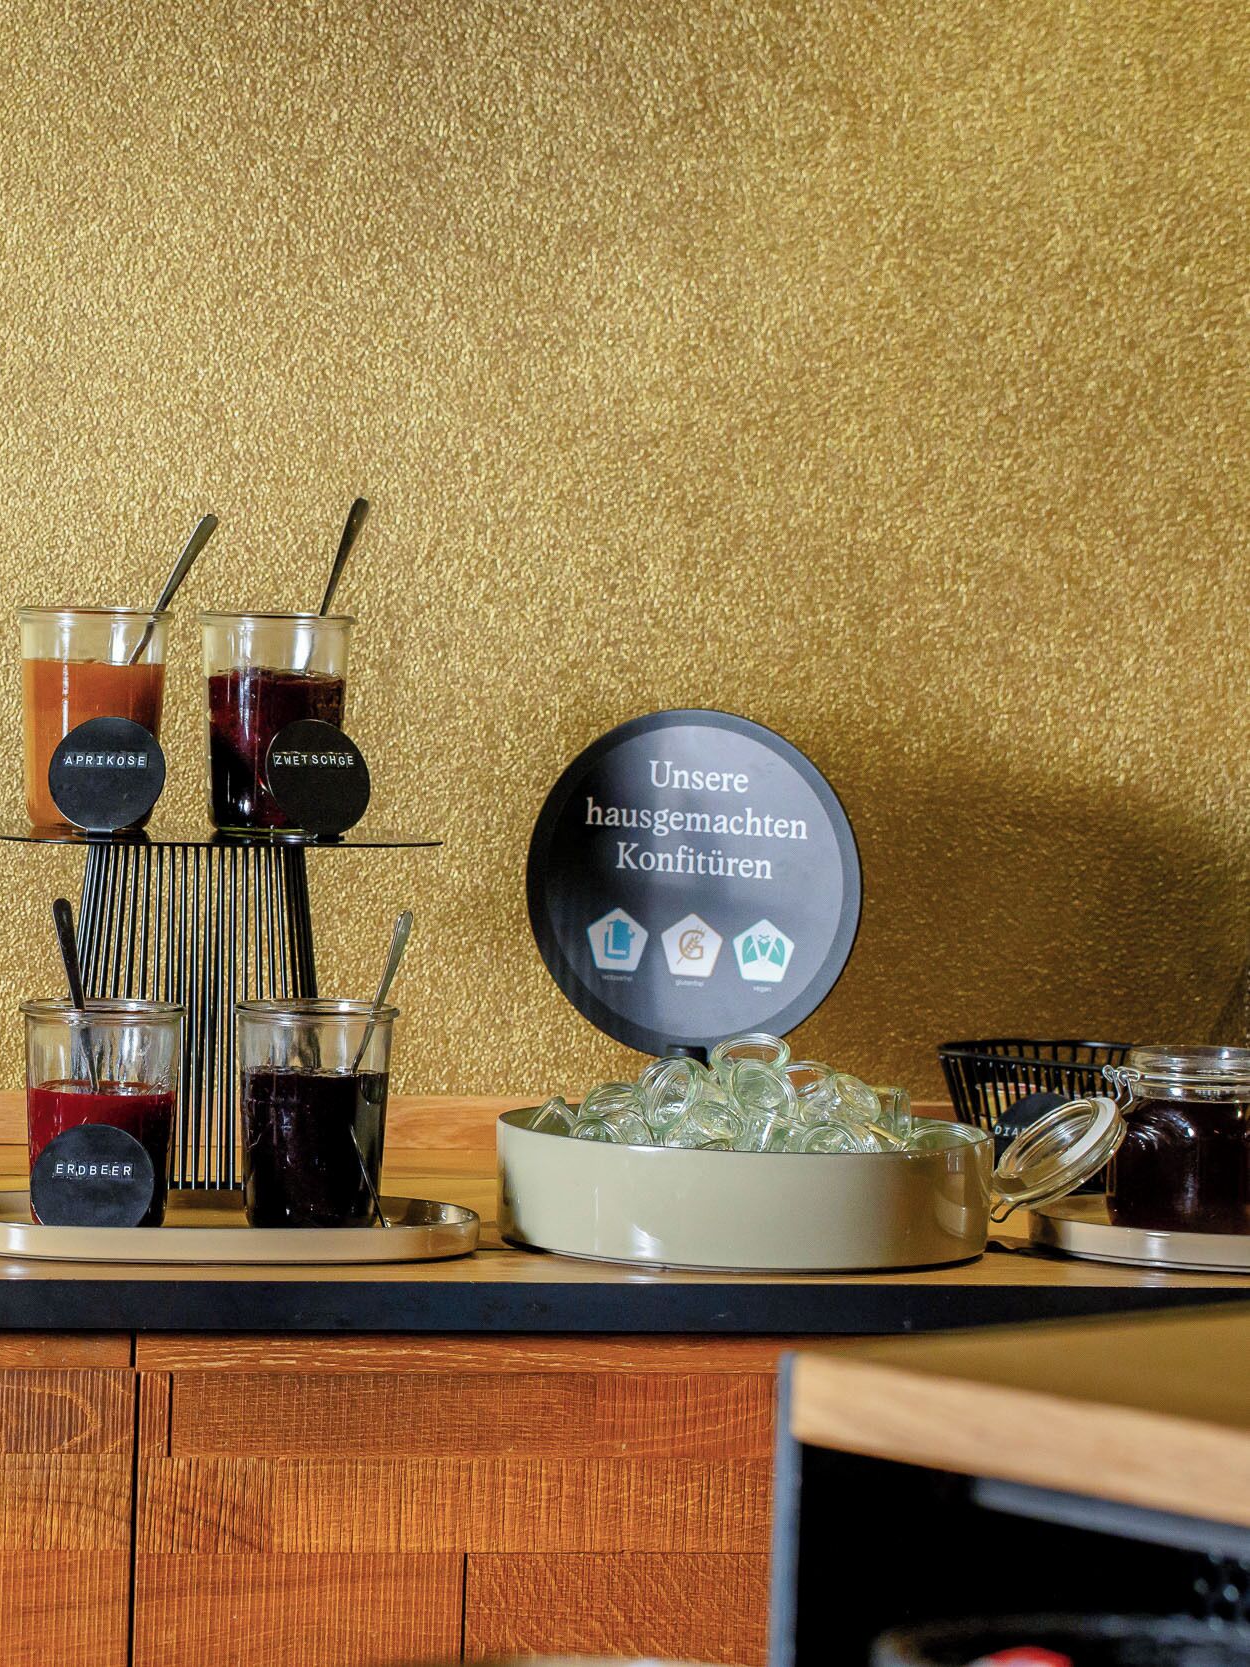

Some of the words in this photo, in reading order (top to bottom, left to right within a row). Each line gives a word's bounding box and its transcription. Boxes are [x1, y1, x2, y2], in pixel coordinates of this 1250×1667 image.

[64, 755, 146, 766] APRIKOSE
[274, 754, 354, 766] ZWETSCHGE
[649, 760, 750, 793] Unsere
[584, 797, 808, 839] hausgemachten
[616, 841, 773, 880] Konfitüren
[55, 1163, 132, 1176] ERDBEER
